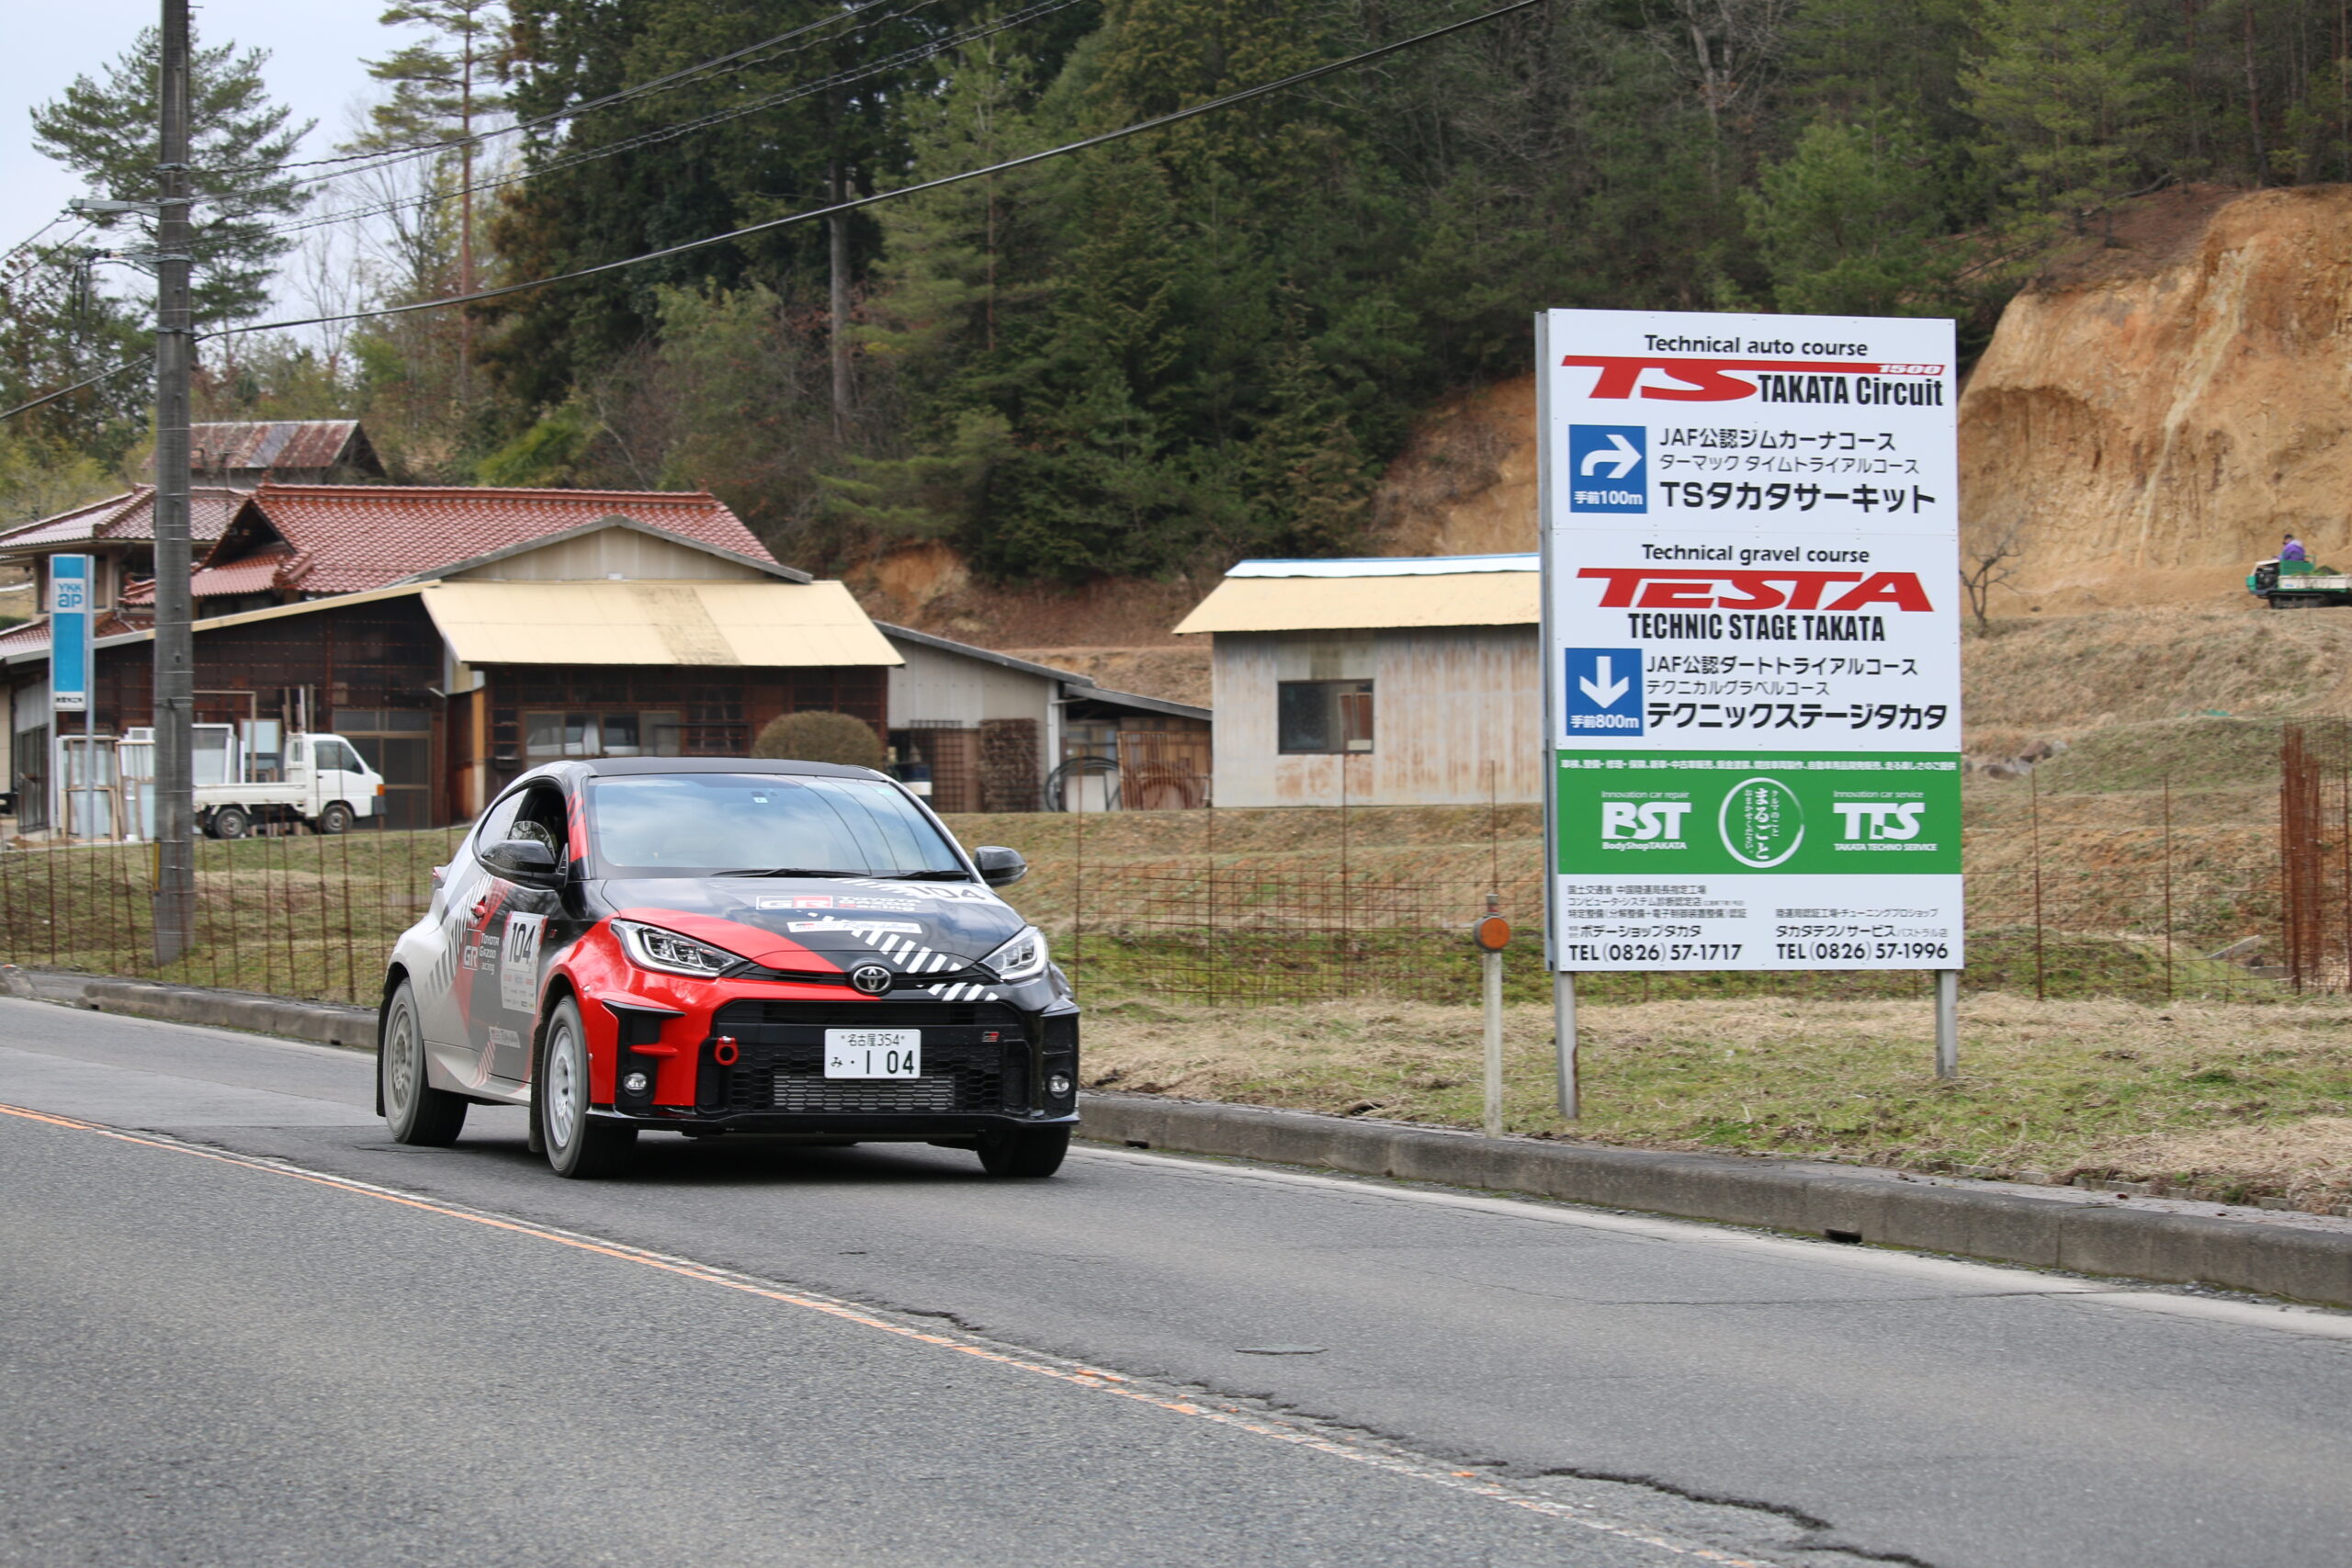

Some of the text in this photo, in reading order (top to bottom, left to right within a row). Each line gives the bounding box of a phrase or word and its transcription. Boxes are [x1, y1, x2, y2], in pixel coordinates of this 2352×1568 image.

[1645, 334, 1868, 356] Technical auto course
[1562, 355, 1758, 402] TS
[1877, 364, 1941, 376] 1500
[1758, 374, 1943, 406] TAKATA Circuit
[1660, 427, 1896, 451] JAF公認ジムカーナコース
[1660, 454, 1919, 475] ターマック タイムトライアルコース
[1574, 490, 1643, 505] 手前100m
[1660, 481, 1936, 513] TSタカタサーキット
[1642, 544, 1870, 566] Technical gravel course
[57, 583, 83, 592] YKK
[1577, 568, 1934, 612] TESTA
[1628, 613, 1885, 641] TECHNIC STAGE TAKATA
[1646, 655, 1917, 676] JAF公認ダートトライアルコース
[1646, 680, 1829, 696] テクニカルグラベルコース
[1570, 714, 1640, 729] 手前800m
[1647, 702, 1947, 729] テクニックステージタカタ
[1601, 802, 1691, 840] BST
[910, 886, 985, 900] 104
[759, 899, 831, 909] GR
[1776, 925, 1895, 938] タカタテクノサービス
[509, 922, 536, 964] 104
[1568, 944, 1600, 961] TEL
[1777, 943, 1806, 959] TEL
[464, 945, 478, 968] GR
[831, 1056, 843, 1067] み
